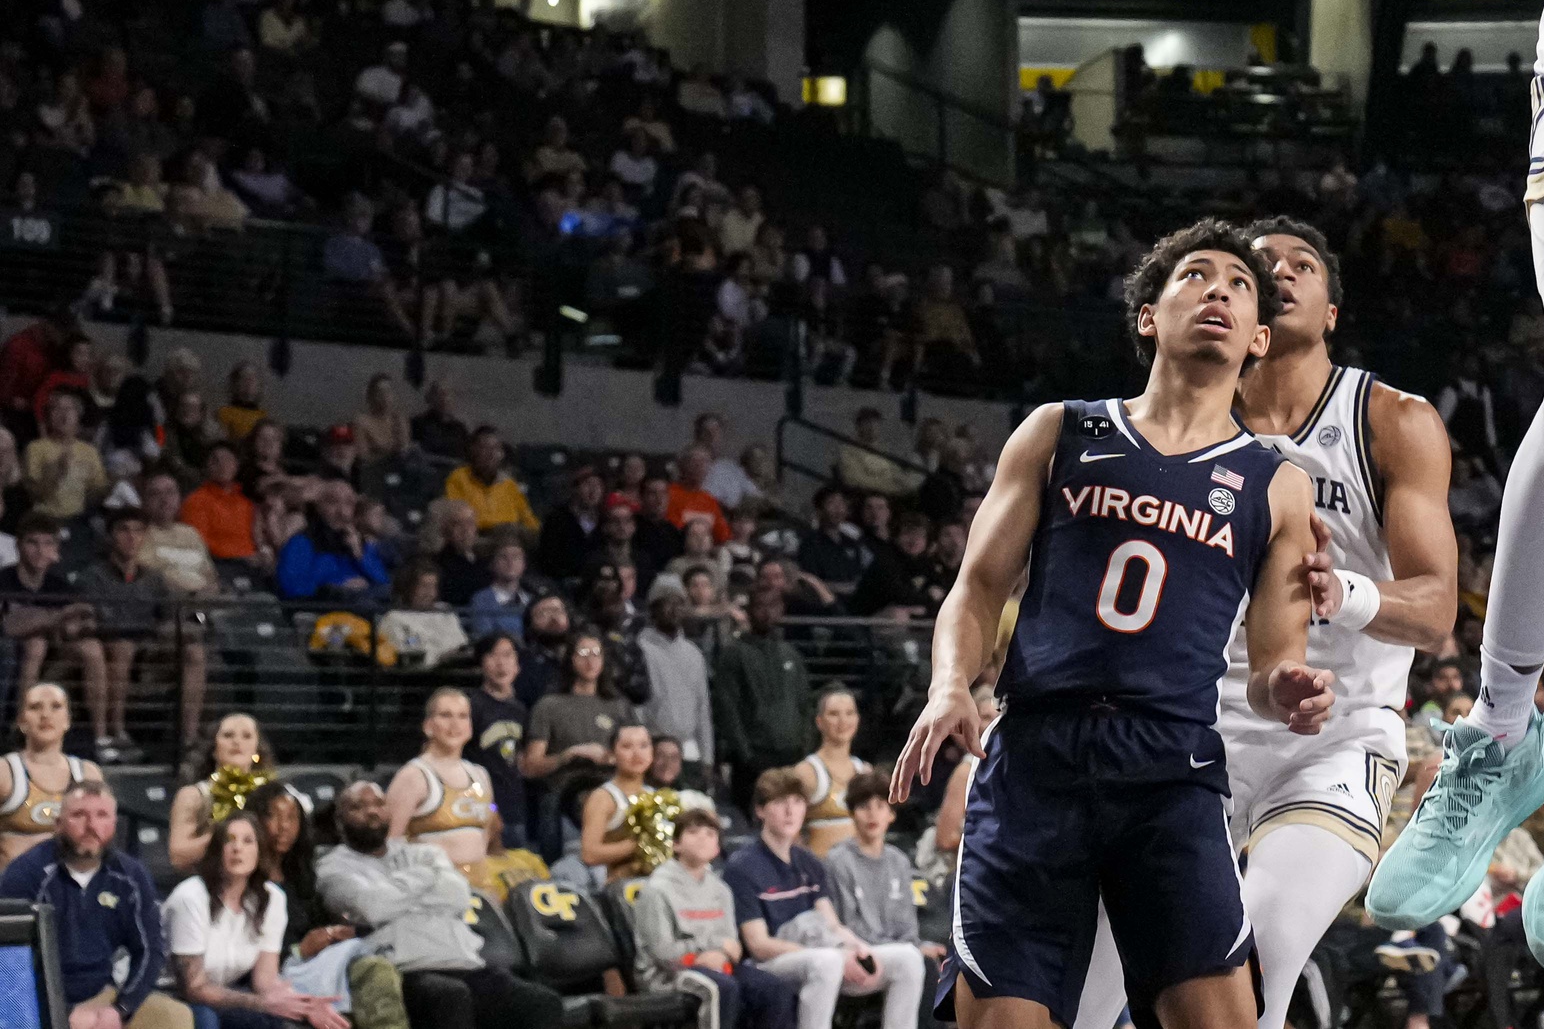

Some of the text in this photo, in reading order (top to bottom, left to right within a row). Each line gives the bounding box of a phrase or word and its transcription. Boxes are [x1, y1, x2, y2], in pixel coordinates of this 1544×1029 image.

[1084, 420, 1109, 429] 15 41
[1062, 486, 1234, 558] VIRGINIA
[1096, 539, 1168, 634] 0
